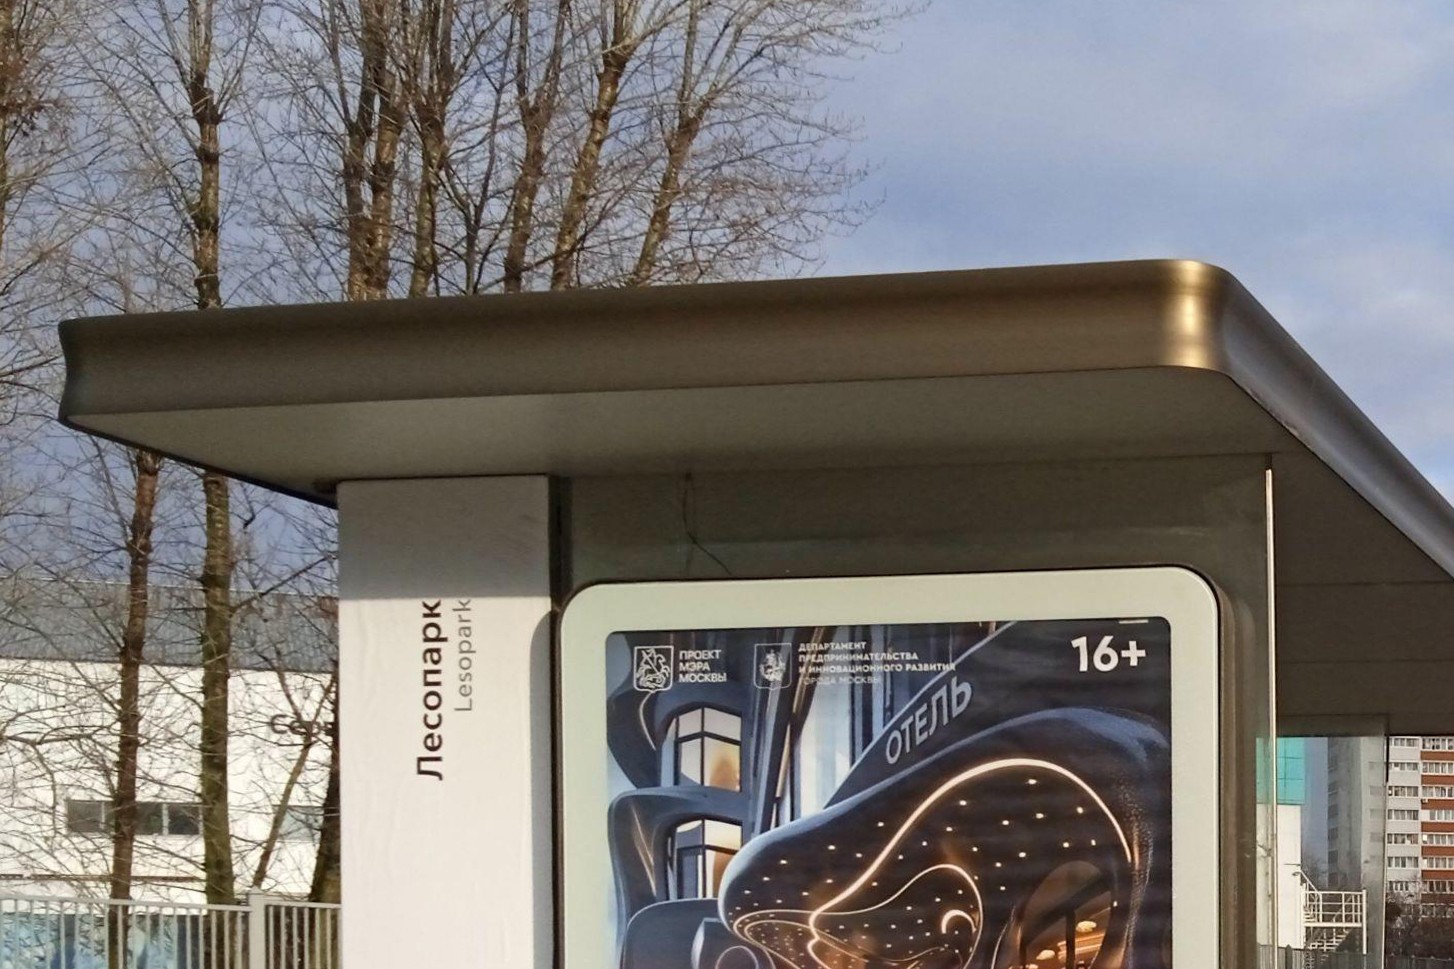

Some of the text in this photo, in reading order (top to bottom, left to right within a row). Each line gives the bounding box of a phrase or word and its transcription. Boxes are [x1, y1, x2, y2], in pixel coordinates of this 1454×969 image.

[798, 641, 867, 652] ДЕПАРТАМЕНТ
[452, 598, 476, 712] Lesopark
[679, 649, 721, 660] ПРОЕКТ
[798, 652, 919, 663] ПРЕДПРИНИМАТЕЛЬСТВА
[1070, 634, 1147, 673] 16+
[679, 661, 711, 672] МЭРА
[809, 664, 903, 674] ИННОВАЦИОННОГО
[905, 663, 957, 672] РАЗВИТИЯ
[679, 672, 728, 683] МОСКВЫ
[799, 676, 837, 686] ОРОДА
[416, 599, 449, 782] Лесопарк
[885, 676, 973, 765] ОТЕЛЬ
